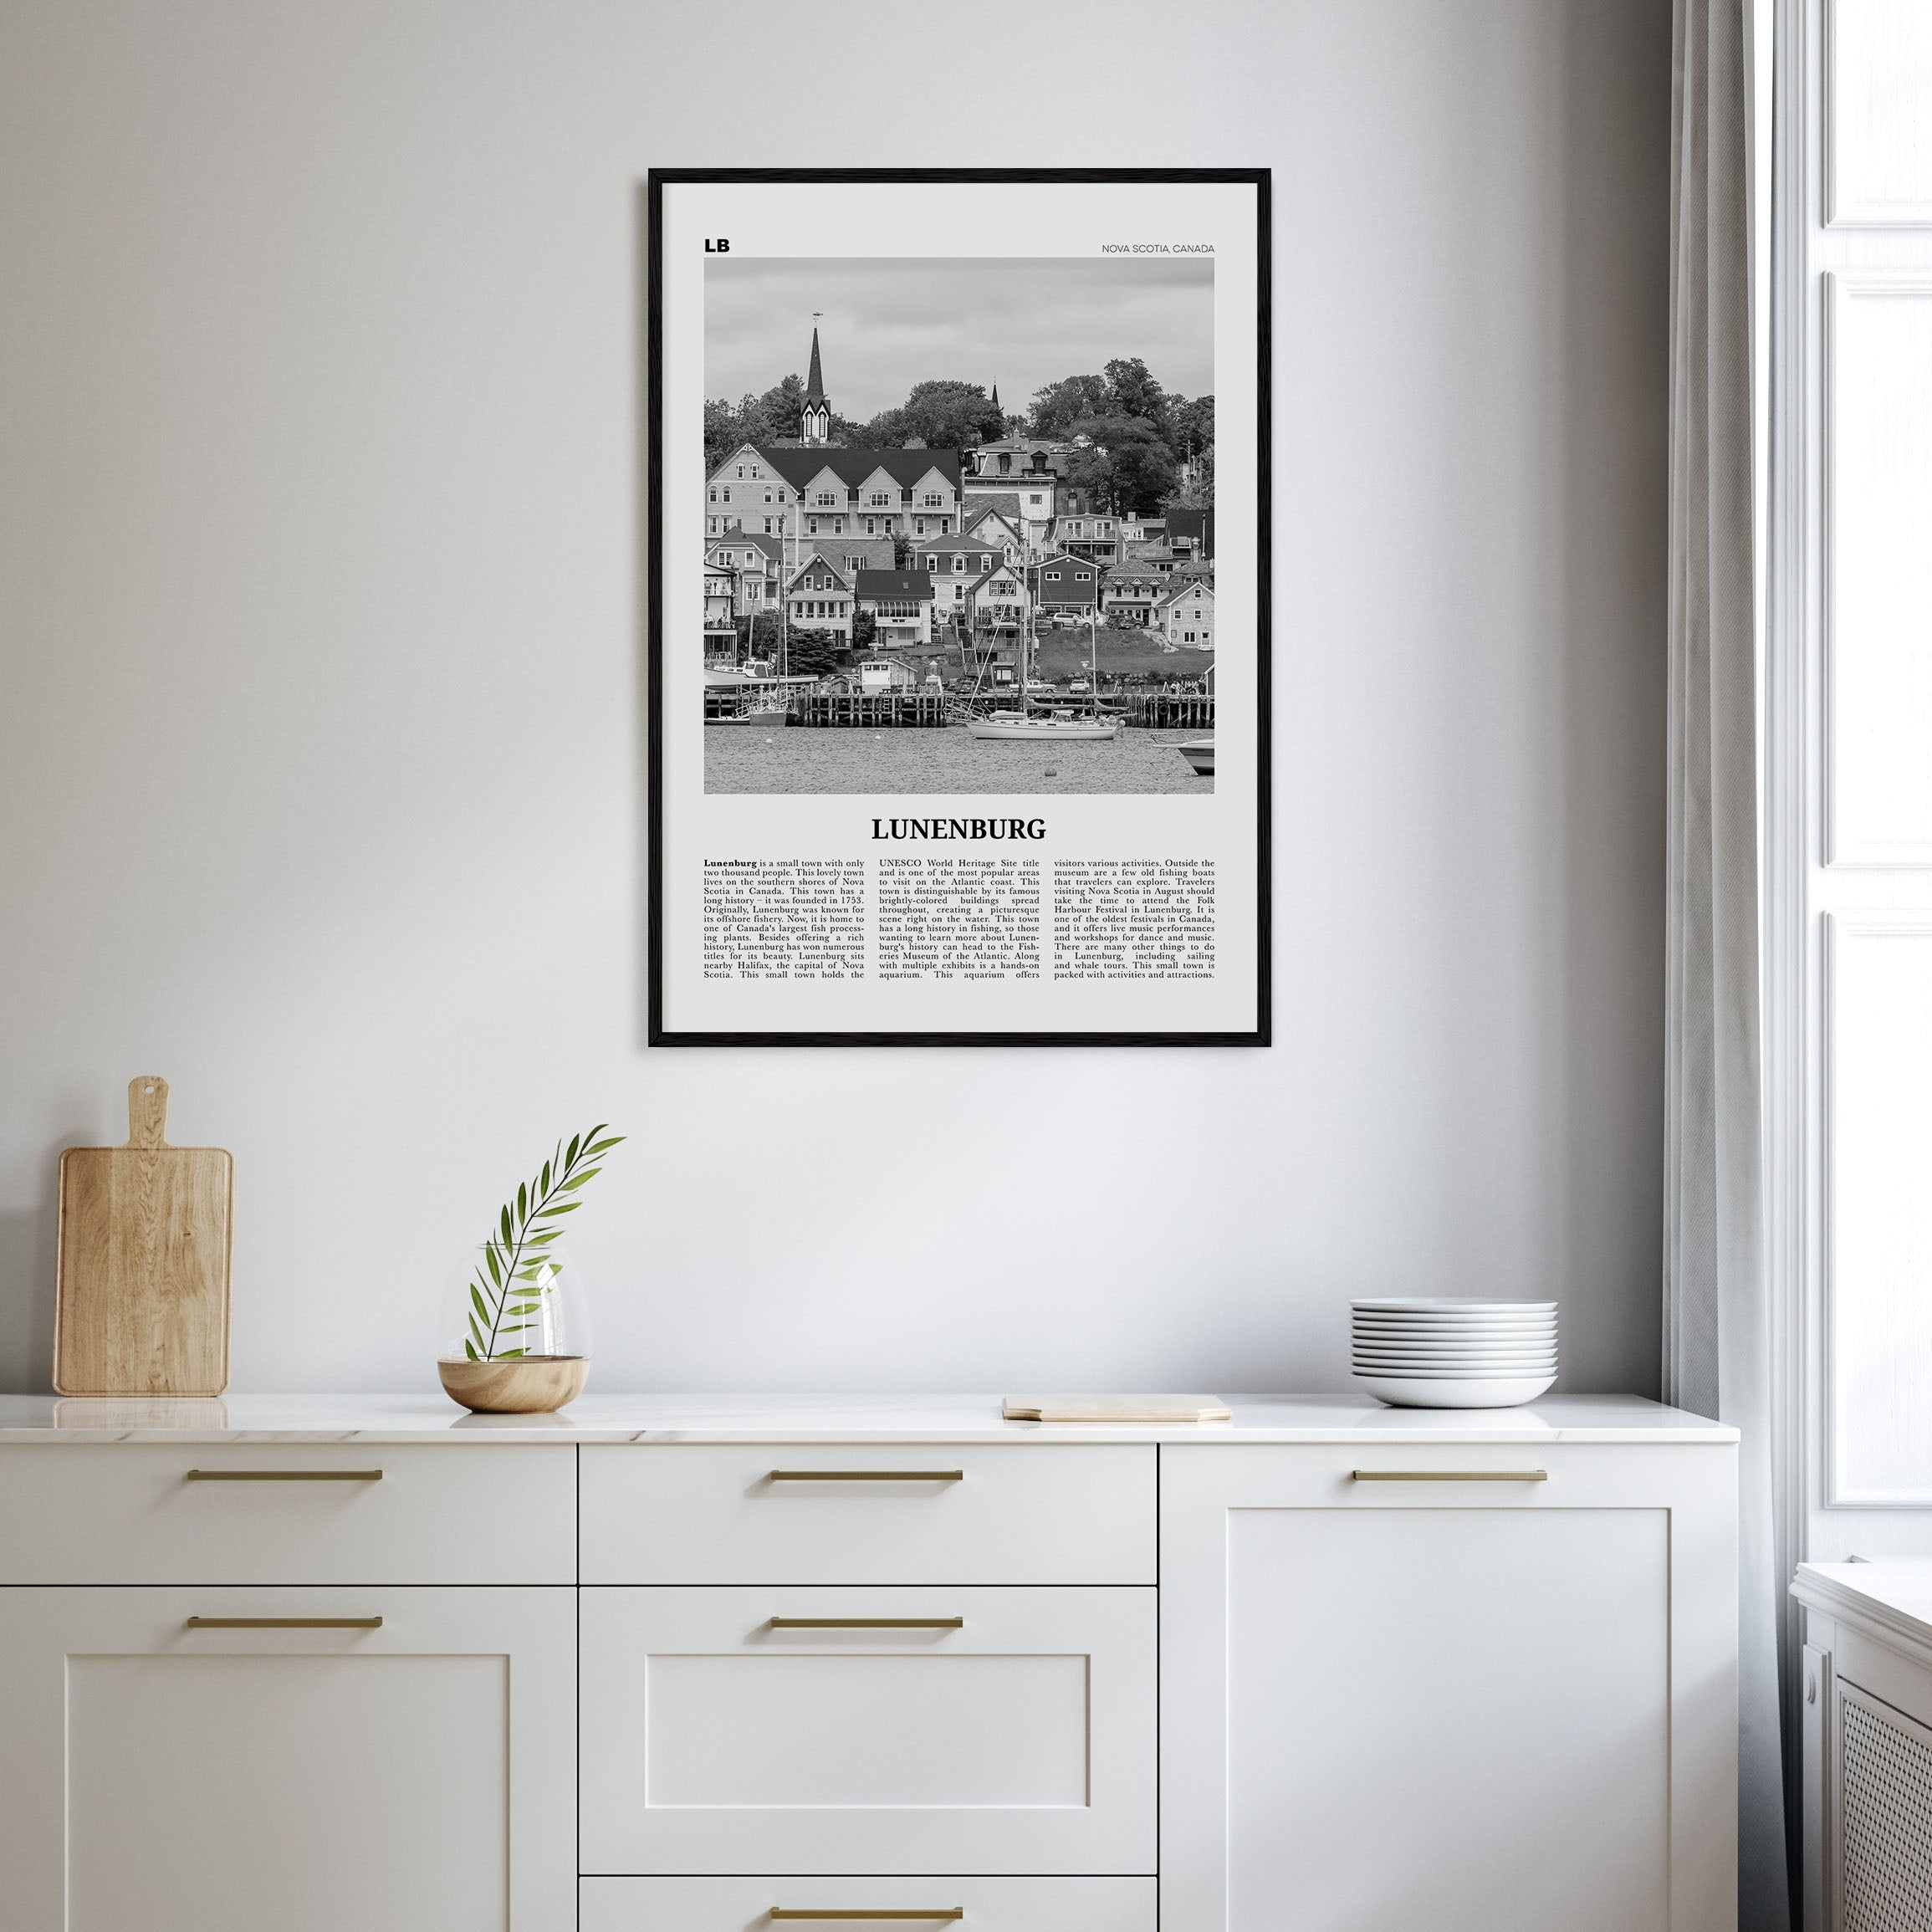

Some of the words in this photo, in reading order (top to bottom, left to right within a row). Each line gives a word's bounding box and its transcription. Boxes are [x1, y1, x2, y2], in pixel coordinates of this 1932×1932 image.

[704, 239, 730, 253] LB
[1101, 243, 1131, 253] NOVA
[1132, 243, 1171, 254] SCOTIA,
[1173, 243, 1215, 253] CANADA
[871, 818, 1046, 840] LUNENBURG
[704, 859, 757, 869] Lunenburg
[846, 859, 865, 869] only
[959, 859, 996, 869] Heritage
[762, 868, 793, 878] people.
[817, 868, 842, 878] lovely
[1136, 878, 1170, 888] explore.
[914, 887, 978, 897] distinguishable
[981, 887, 992, 897] by
[1054, 887, 1085, 897] visiting
[1154, 887, 1184, 897] August
[879, 896, 948, 906] brightly-colored
[960, 896, 999, 906] buildings
[1011, 896, 1039, 906] spread
[704, 906, 749, 916] Originally,
[753, 906, 799, 916] Lunenburg
[879, 906, 929, 916] throughout,
[936, 906, 971, 916] creating
[990, 906, 1040, 916] picturesque
[1144, 906, 1192, 916] Lunenburg.
[779, 924, 807, 934] largest
[1157, 924, 1215, 934] performances
[704, 933, 717, 943] ing
[724, 933, 752, 943] plants.
[796, 933, 830, 943] offering
[879, 933, 913, 943] wanting
[1074, 933, 1118, 943] workshops
[704, 943, 735, 953] history,
[738, 943, 784, 953] Lunenburg
[763, 952, 793, 962] beauty.
[799, 952, 846, 962] Lunenburg
[1014, 952, 1040, 962] Along
[1075, 952, 1124, 962] Lunenburg,
[1135, 952, 1176, 962] including
[1187, 952, 1215, 962] sailing
[704, 961, 733, 971] nearby
[738, 961, 772, 971] Halifax,
[794, 961, 823, 971] capital
[902, 961, 937, 971] multiple
[879, 971, 923, 981] aquarium.
[964, 971, 1004, 981] aquarium
[1054, 971, 1084, 981] packed
